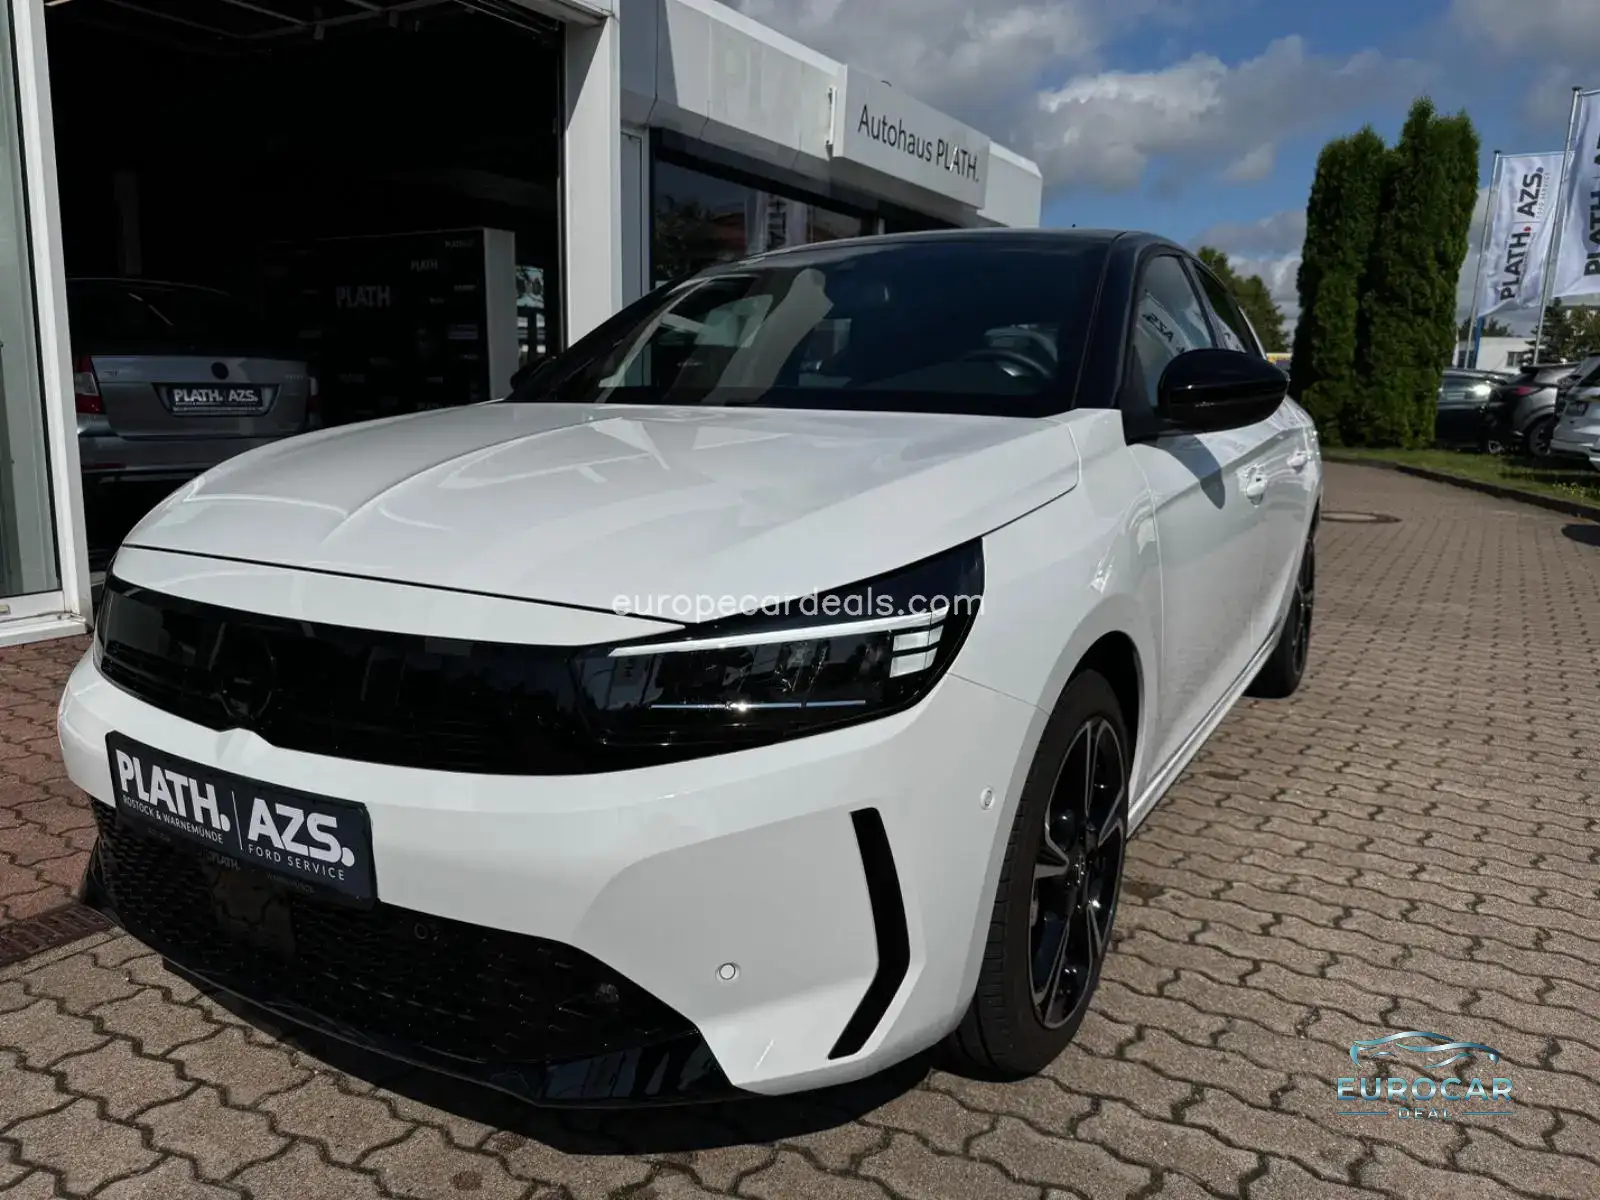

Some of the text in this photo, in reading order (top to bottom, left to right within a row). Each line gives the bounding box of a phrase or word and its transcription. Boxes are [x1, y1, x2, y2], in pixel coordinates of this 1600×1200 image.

[857, 105, 979, 183] Autohaus PLATH.
[1500, 225, 1532, 300] PLATH.
[1517, 166, 1544, 218] AZS.
[173, 388, 259, 402] PLATH. AZS.
[116, 749, 355, 867] PLATH. AZS.
[122, 794, 155, 818] ROSTOCK
[156, 812, 162, 820] &
[248, 843, 345, 881] FORD SERVICE
